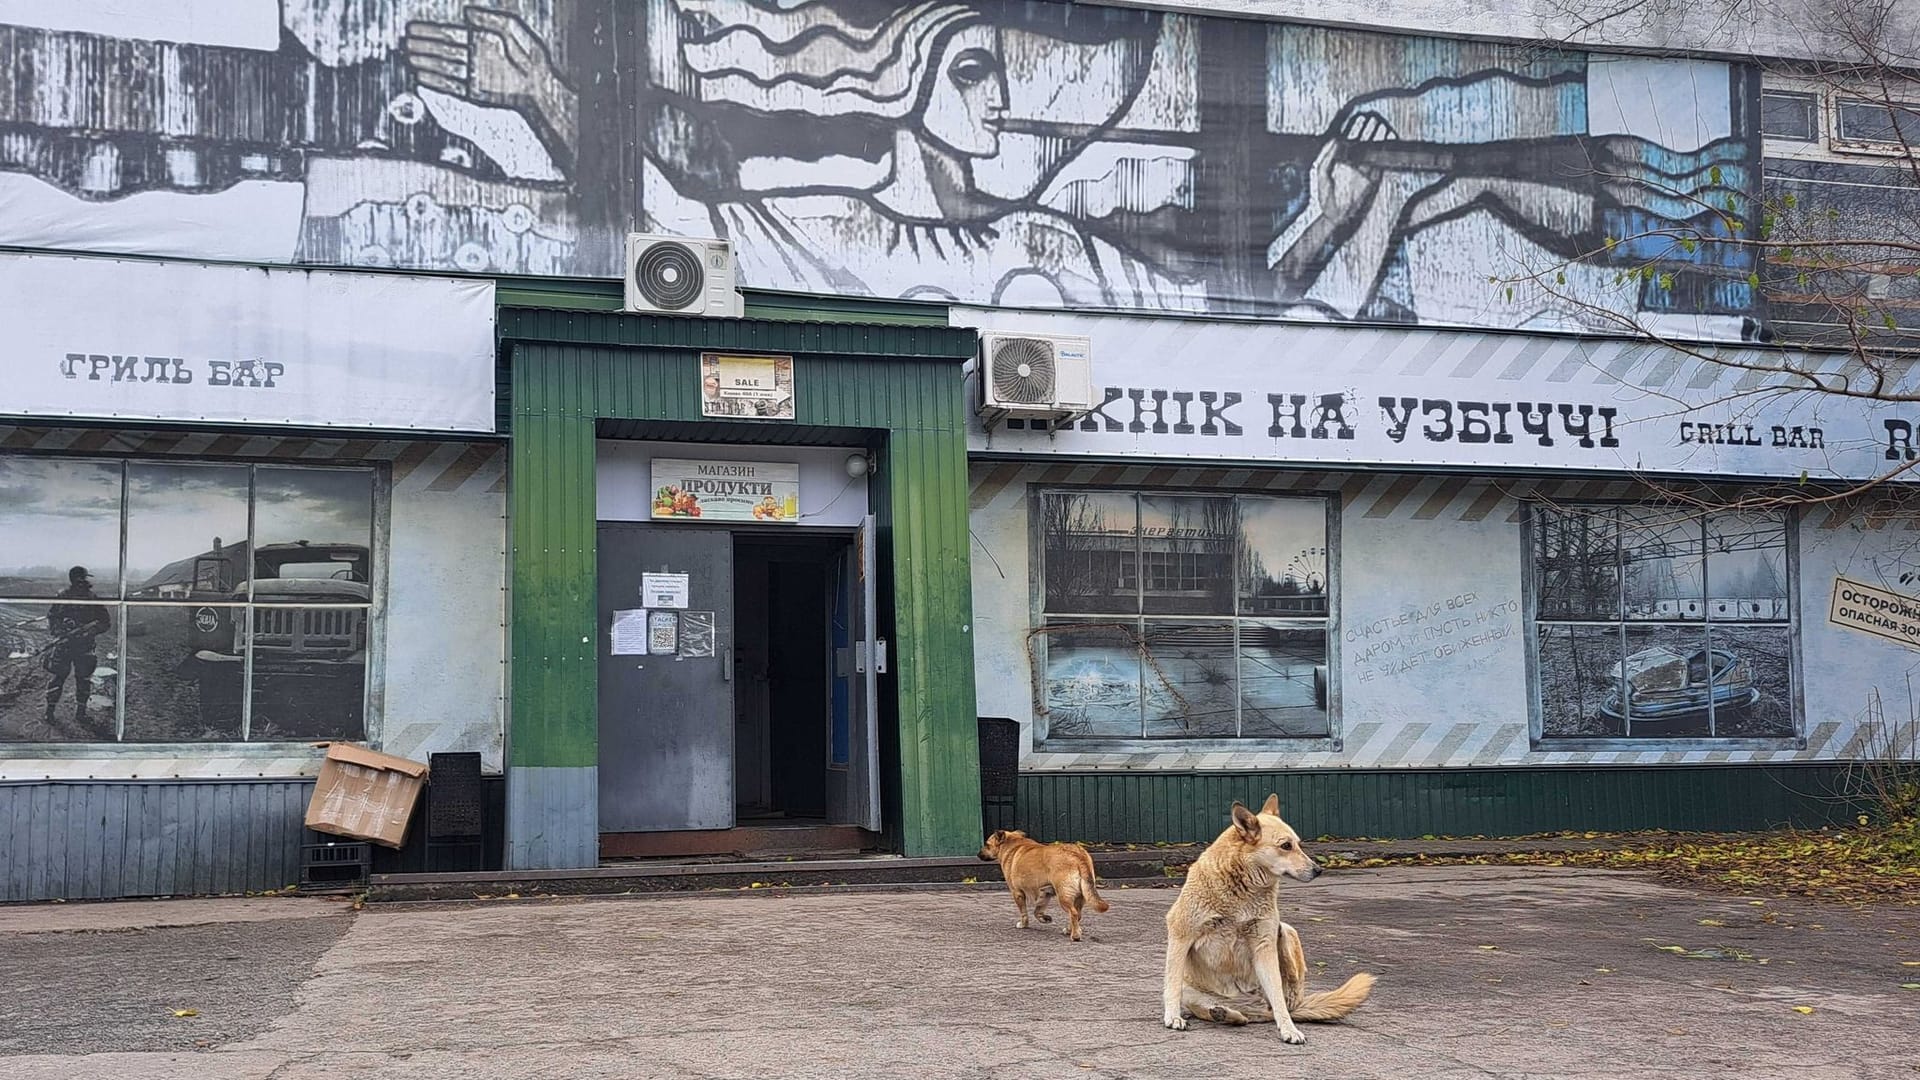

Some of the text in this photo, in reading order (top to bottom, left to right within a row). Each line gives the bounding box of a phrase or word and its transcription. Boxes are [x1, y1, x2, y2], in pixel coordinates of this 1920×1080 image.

[65, 353, 285, 388] ГРИЛЬ БАР
[735, 378, 760, 387] SALE
[1007, 387, 1620, 449] КНІК НА УЗБІЧЧІ
[1680, 422, 1825, 450] GRILL BAR
[1884, 419, 1920, 461] R
[697, 464, 755, 477] МАГАЗИН
[681, 479, 773, 497] ПРОДУКТИ
[1345, 591, 1480, 643] СЧАСТЬЕ ДЛЯ ВСЕХ
[1423, 617, 1471, 641] ПУСТЬ
[1839, 607, 1898, 631] ОПАСНАЯ
[1358, 669, 1375, 685] НЕ
